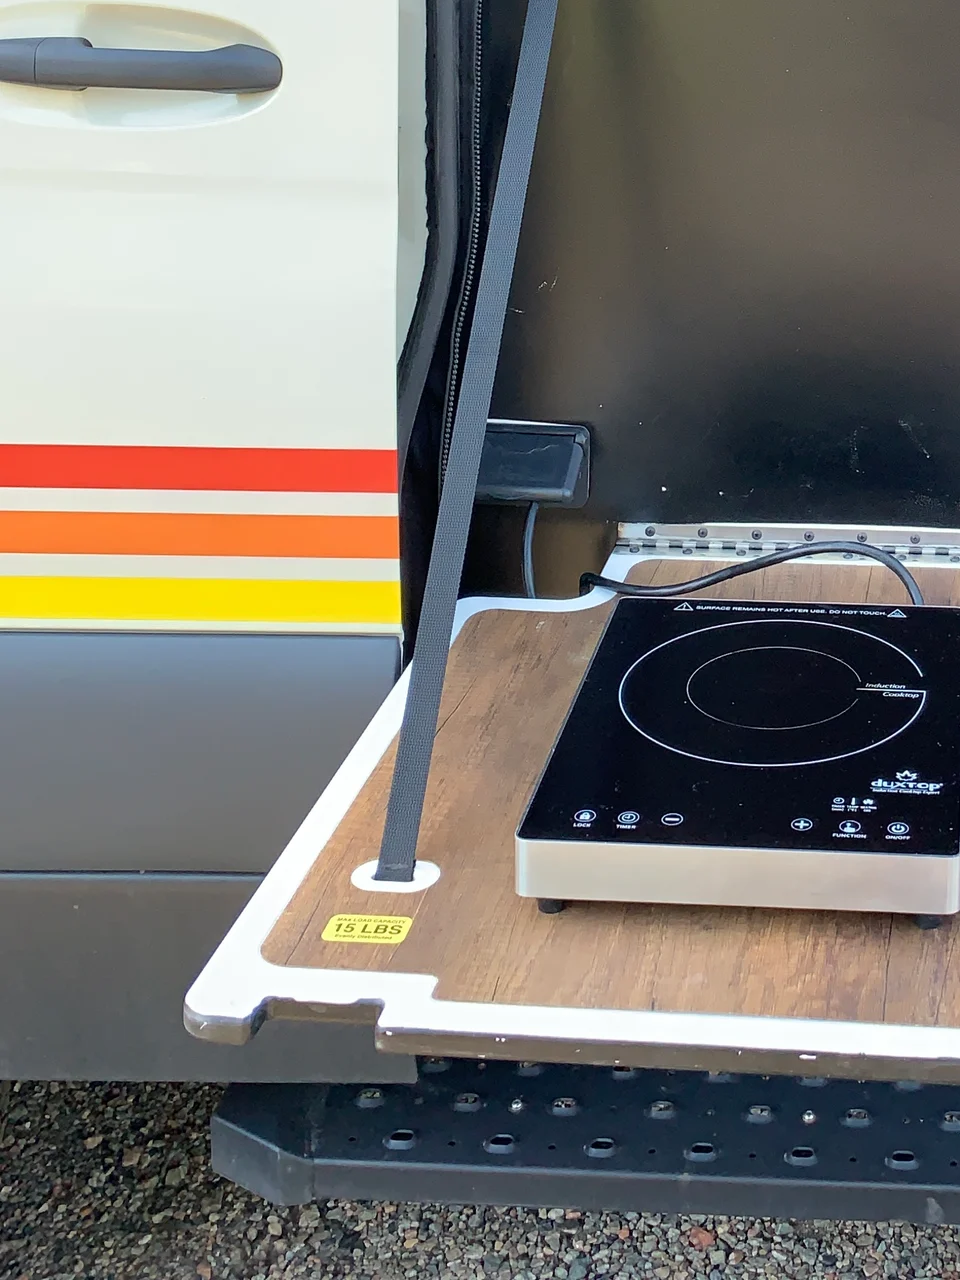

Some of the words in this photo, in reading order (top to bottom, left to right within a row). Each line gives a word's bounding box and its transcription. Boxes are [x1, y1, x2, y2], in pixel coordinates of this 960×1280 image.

[864, 682, 906, 690] Induction
[882, 691, 920, 699] Cooktop
[335, 923, 357, 933] 15
[360, 923, 404, 935] LBS
